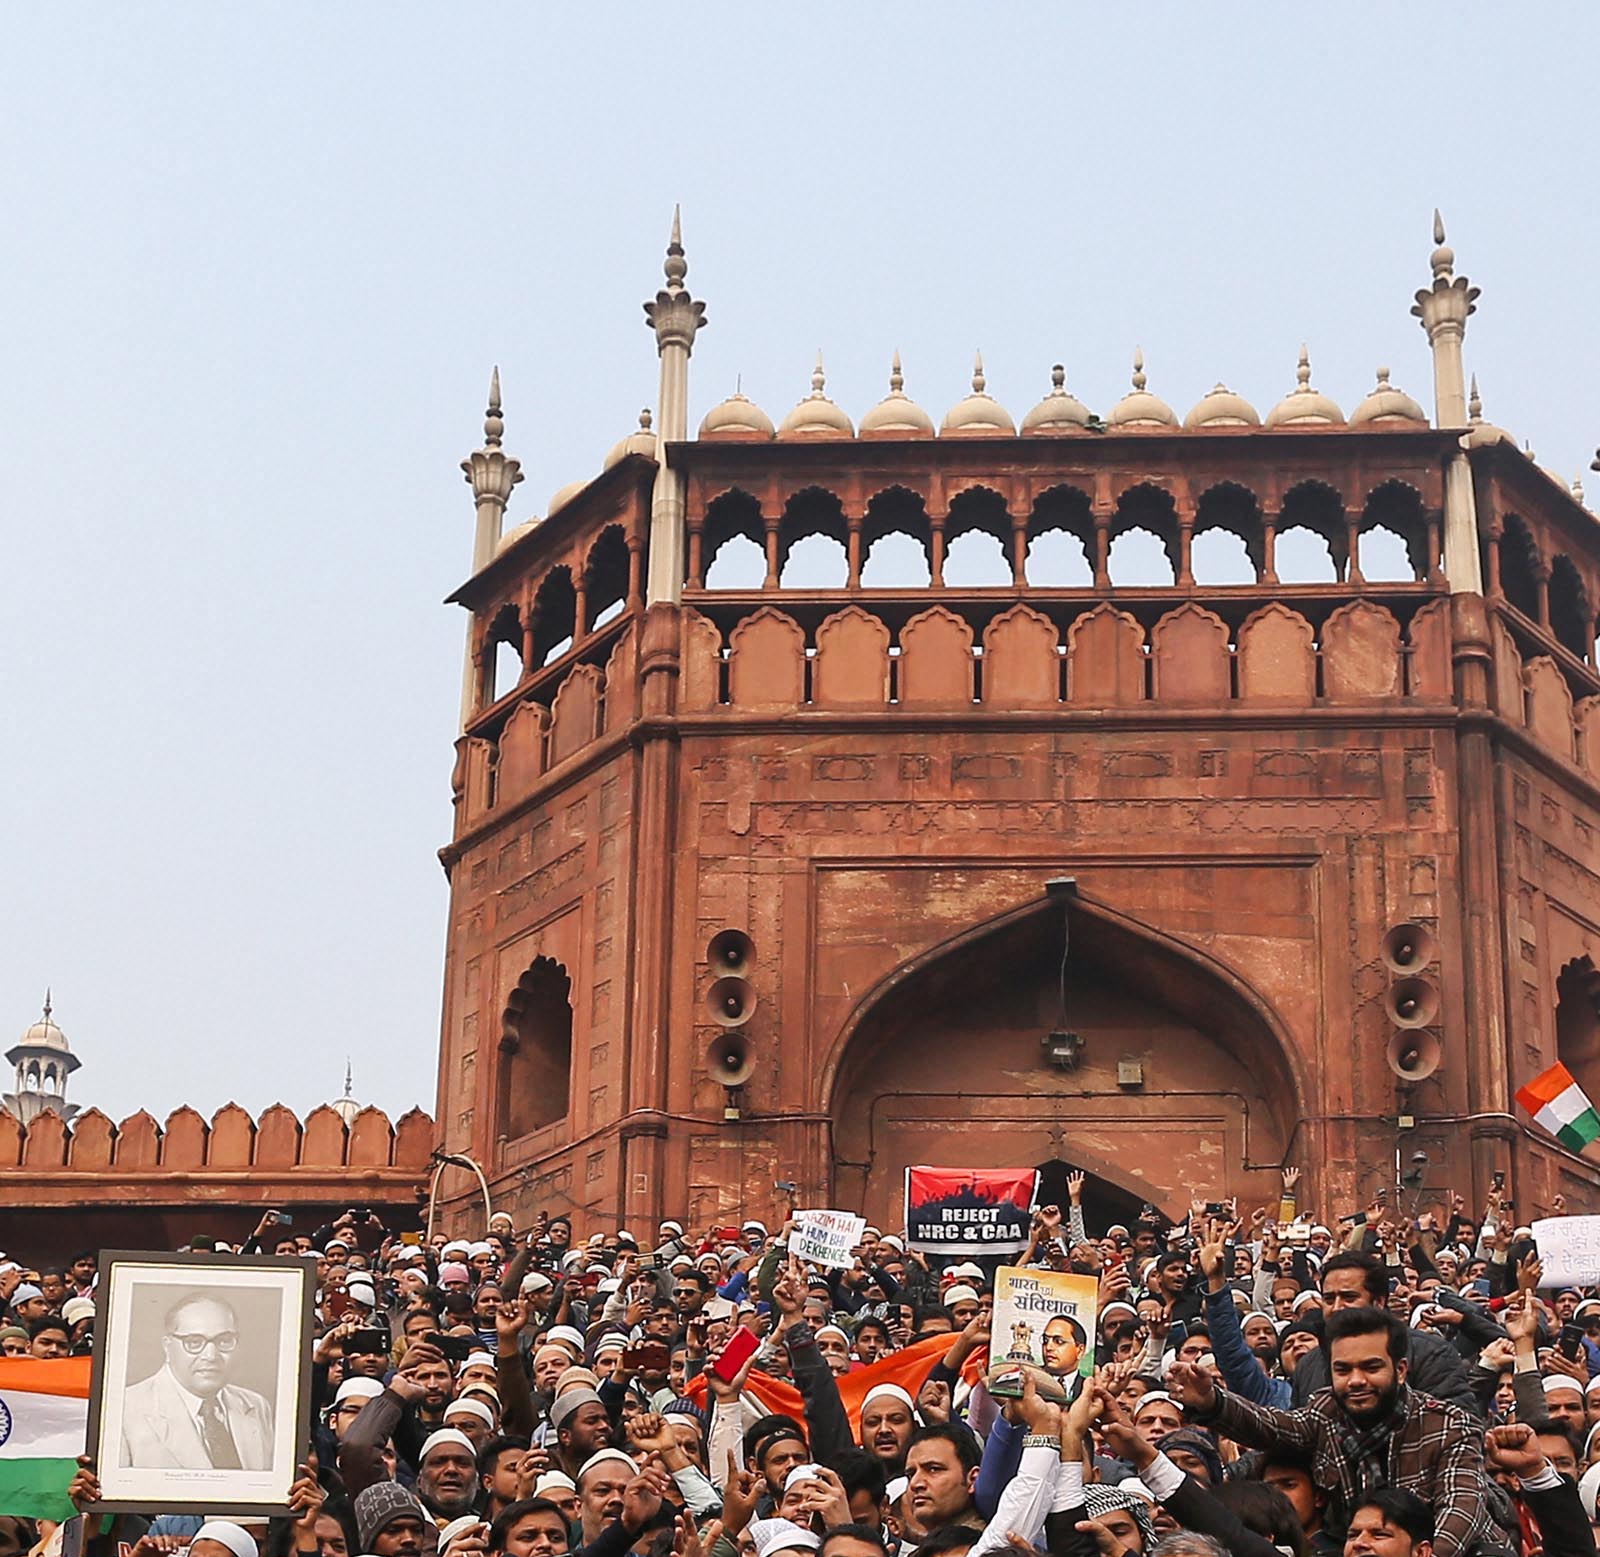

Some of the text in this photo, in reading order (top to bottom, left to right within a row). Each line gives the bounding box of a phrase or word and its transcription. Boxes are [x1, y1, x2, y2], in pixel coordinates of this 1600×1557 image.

[942, 1208, 1000, 1222] REJECT
[837, 1219, 856, 1233] HAI
[918, 1223, 1022, 1240] NRC & CAA
[806, 1224, 828, 1244] HUM
[829, 1233, 846, 1247] BHI
[799, 1238, 847, 1263] DEKHENGE
[1009, 1277, 1040, 1291] भारत
[1013, 1292, 1078, 1315] संविधान
